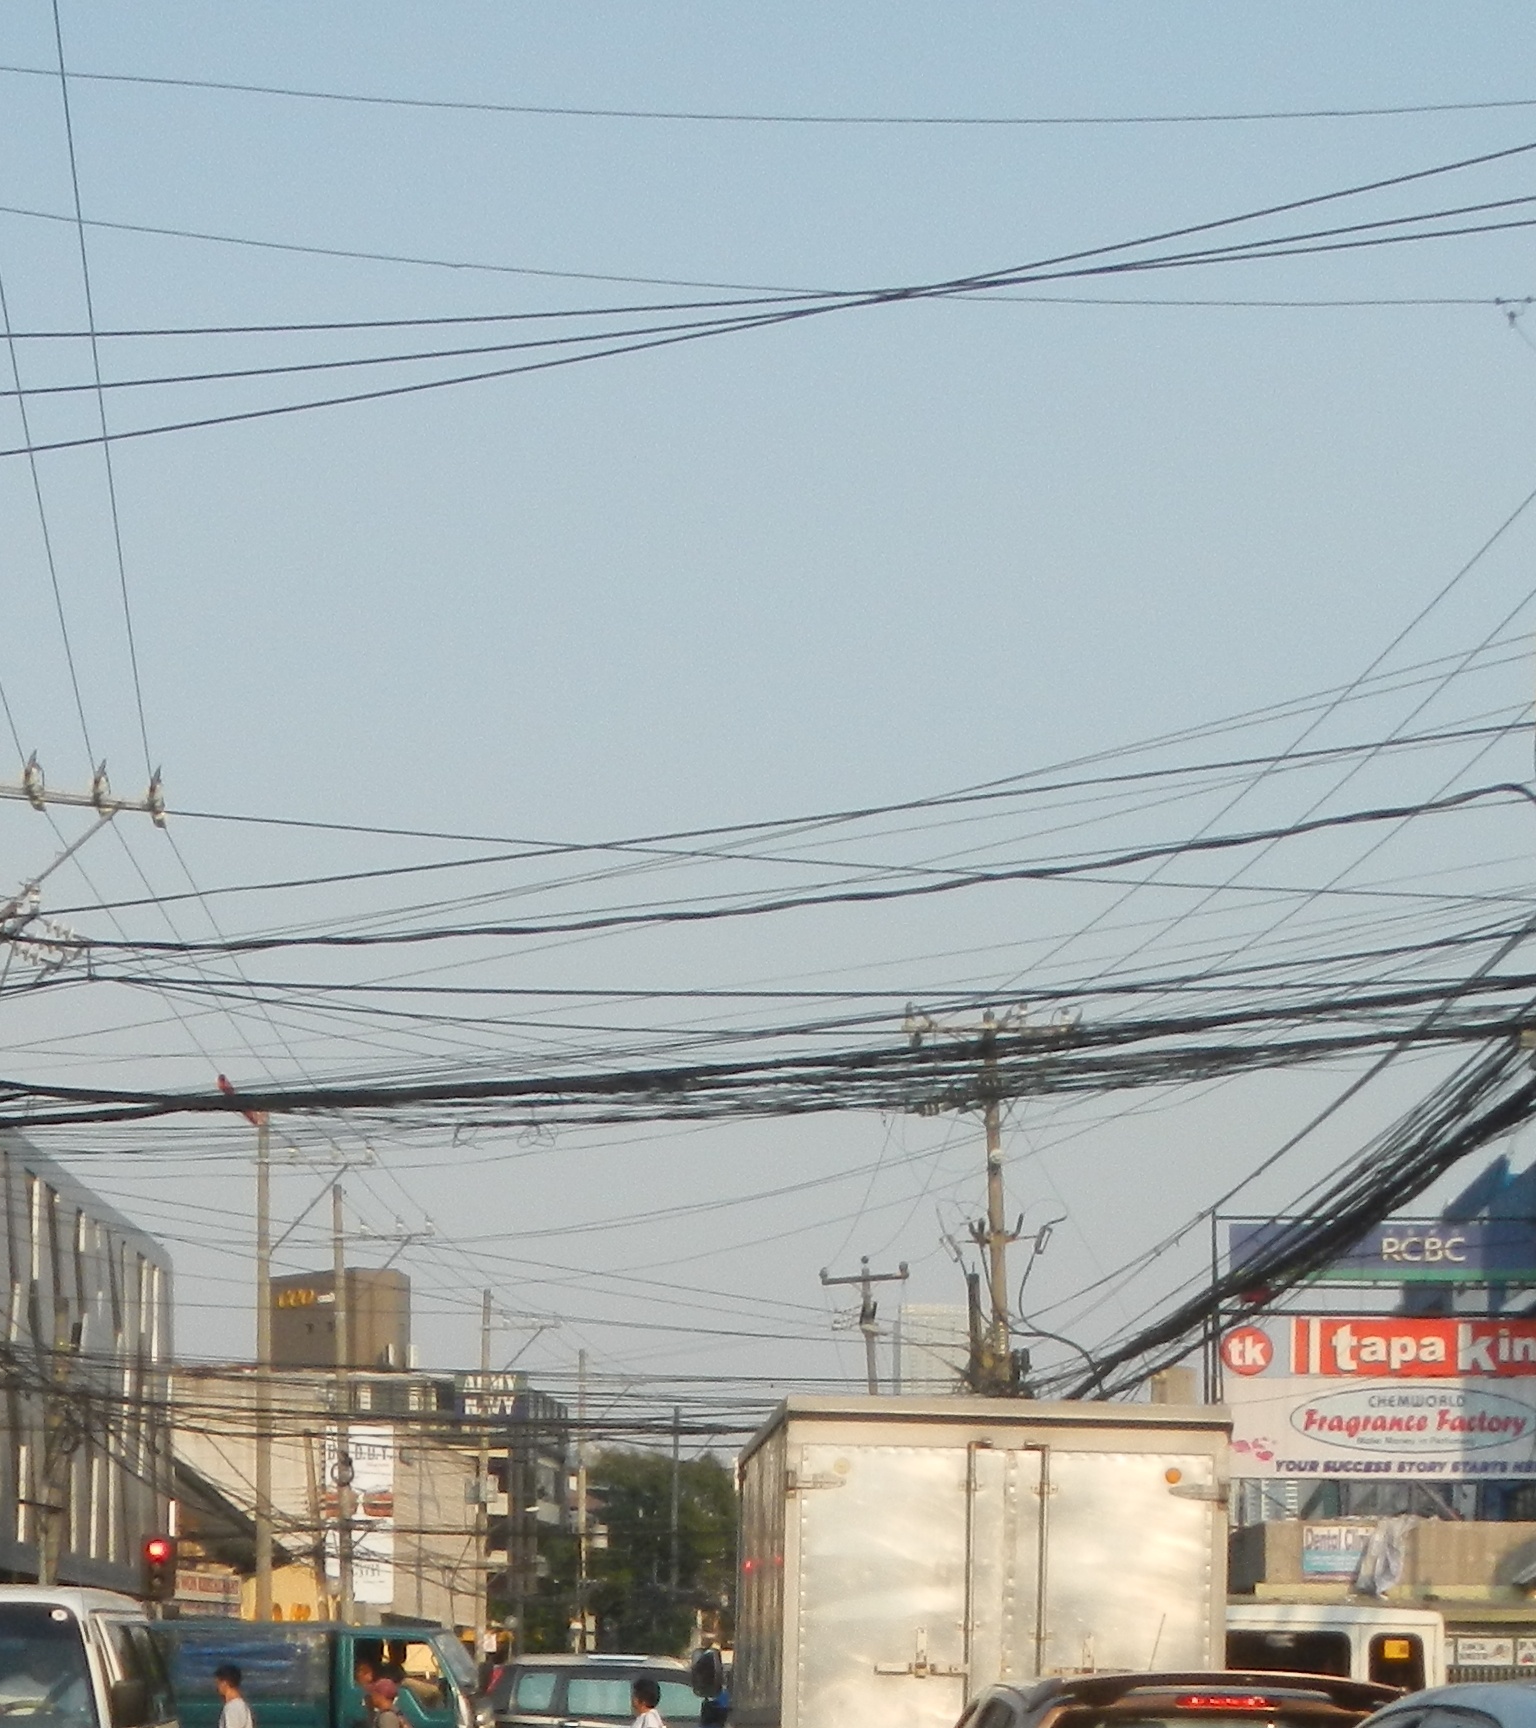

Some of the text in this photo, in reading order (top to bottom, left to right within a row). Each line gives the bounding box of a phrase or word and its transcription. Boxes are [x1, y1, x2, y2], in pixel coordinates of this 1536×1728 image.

[1381, 1236, 1467, 1263] RCBC
[1228, 1334, 1267, 1367] tk
[1331, 1323, 1446, 1371] tapa
[1367, 1394, 1466, 1409] CHEMWORLD
[1302, 1408, 1527, 1439] Fragrance Factory
[1274, 1460, 1318, 1474] YOUR
[1322, 1460, 1392, 1474] SUCCESS
[1397, 1460, 1449, 1474] STORY
[1451, 1460, 1508, 1474] STARTS
[1304, 1528, 1342, 1551] Dental
